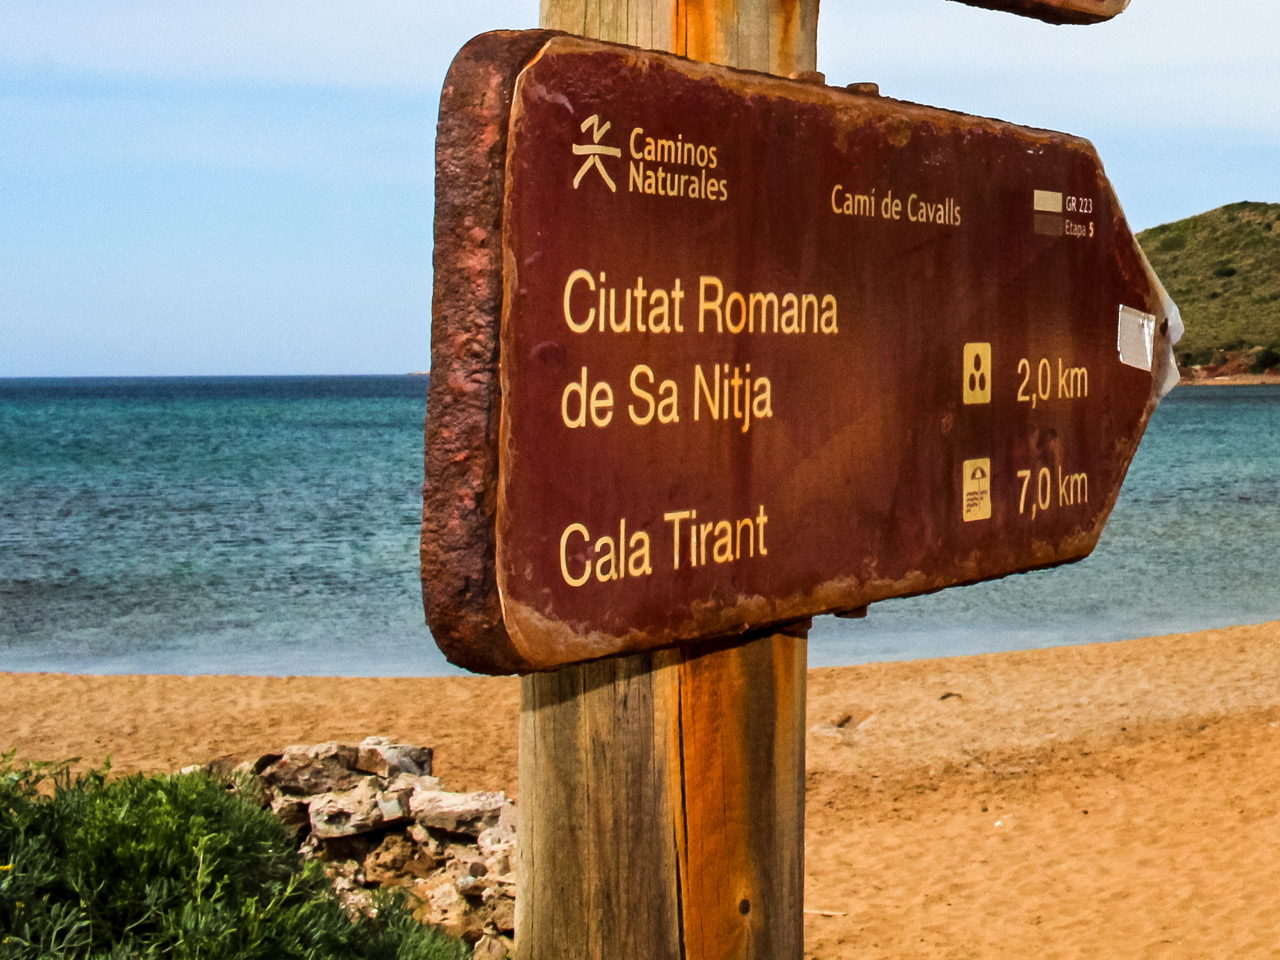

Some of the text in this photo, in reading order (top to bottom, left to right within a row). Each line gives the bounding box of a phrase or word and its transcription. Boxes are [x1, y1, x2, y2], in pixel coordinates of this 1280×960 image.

[629, 127, 718, 169] Caminos
[628, 161, 728, 201] Naturales
[831, 184, 961, 226] Camí de Cavalls
[1065, 196, 1093, 214] GR 223
[1065, 219, 1094, 238] Etapa 5
[563, 268, 838, 334] Ciutat Romana
[561, 363, 773, 433] de Sa Nitja
[1017, 357, 1088, 409] 2,0 km
[1017, 466, 1088, 520] 7,0 km
[560, 505, 768, 587] Cala Tirant
